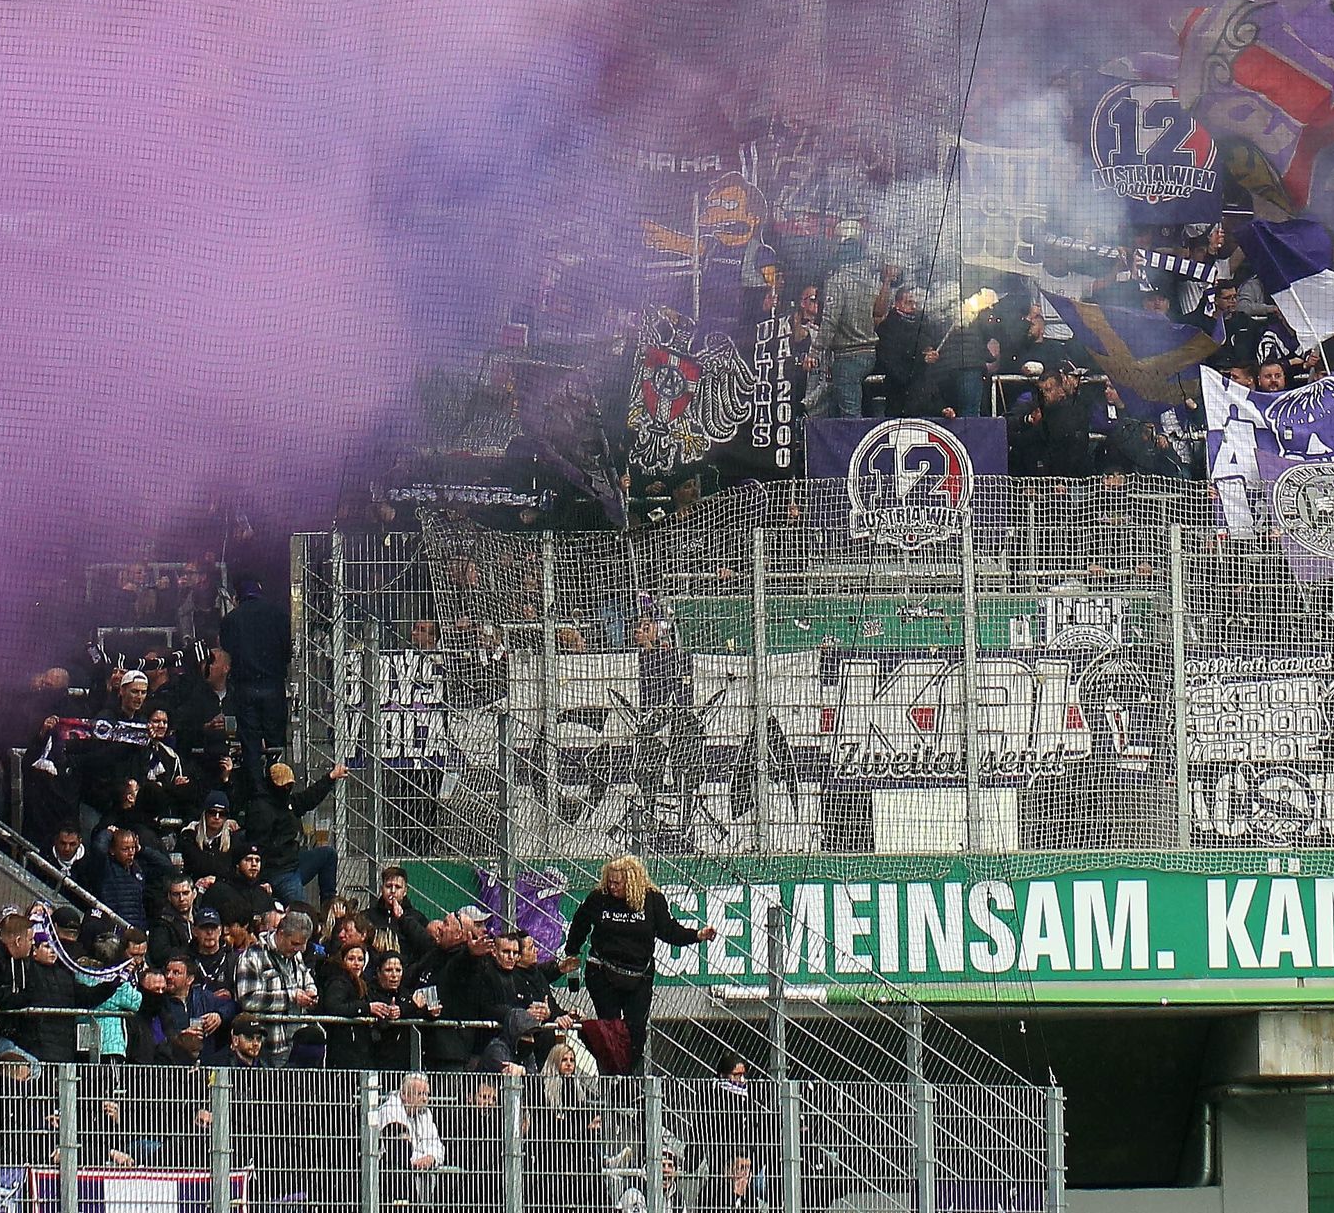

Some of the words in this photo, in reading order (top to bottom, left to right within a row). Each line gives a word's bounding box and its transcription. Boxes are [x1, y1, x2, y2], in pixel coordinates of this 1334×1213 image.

[1108, 97, 1196, 167] 12
[1092, 165, 1166, 191] AUSTRIA
[1167, 165, 1216, 192] WIEN
[753, 319, 774, 447] ULTRAS
[868, 443, 952, 509] 12
[1186, 677, 1319, 715] EKTION
[651, 879, 1175, 976] GEMEINSAM.
